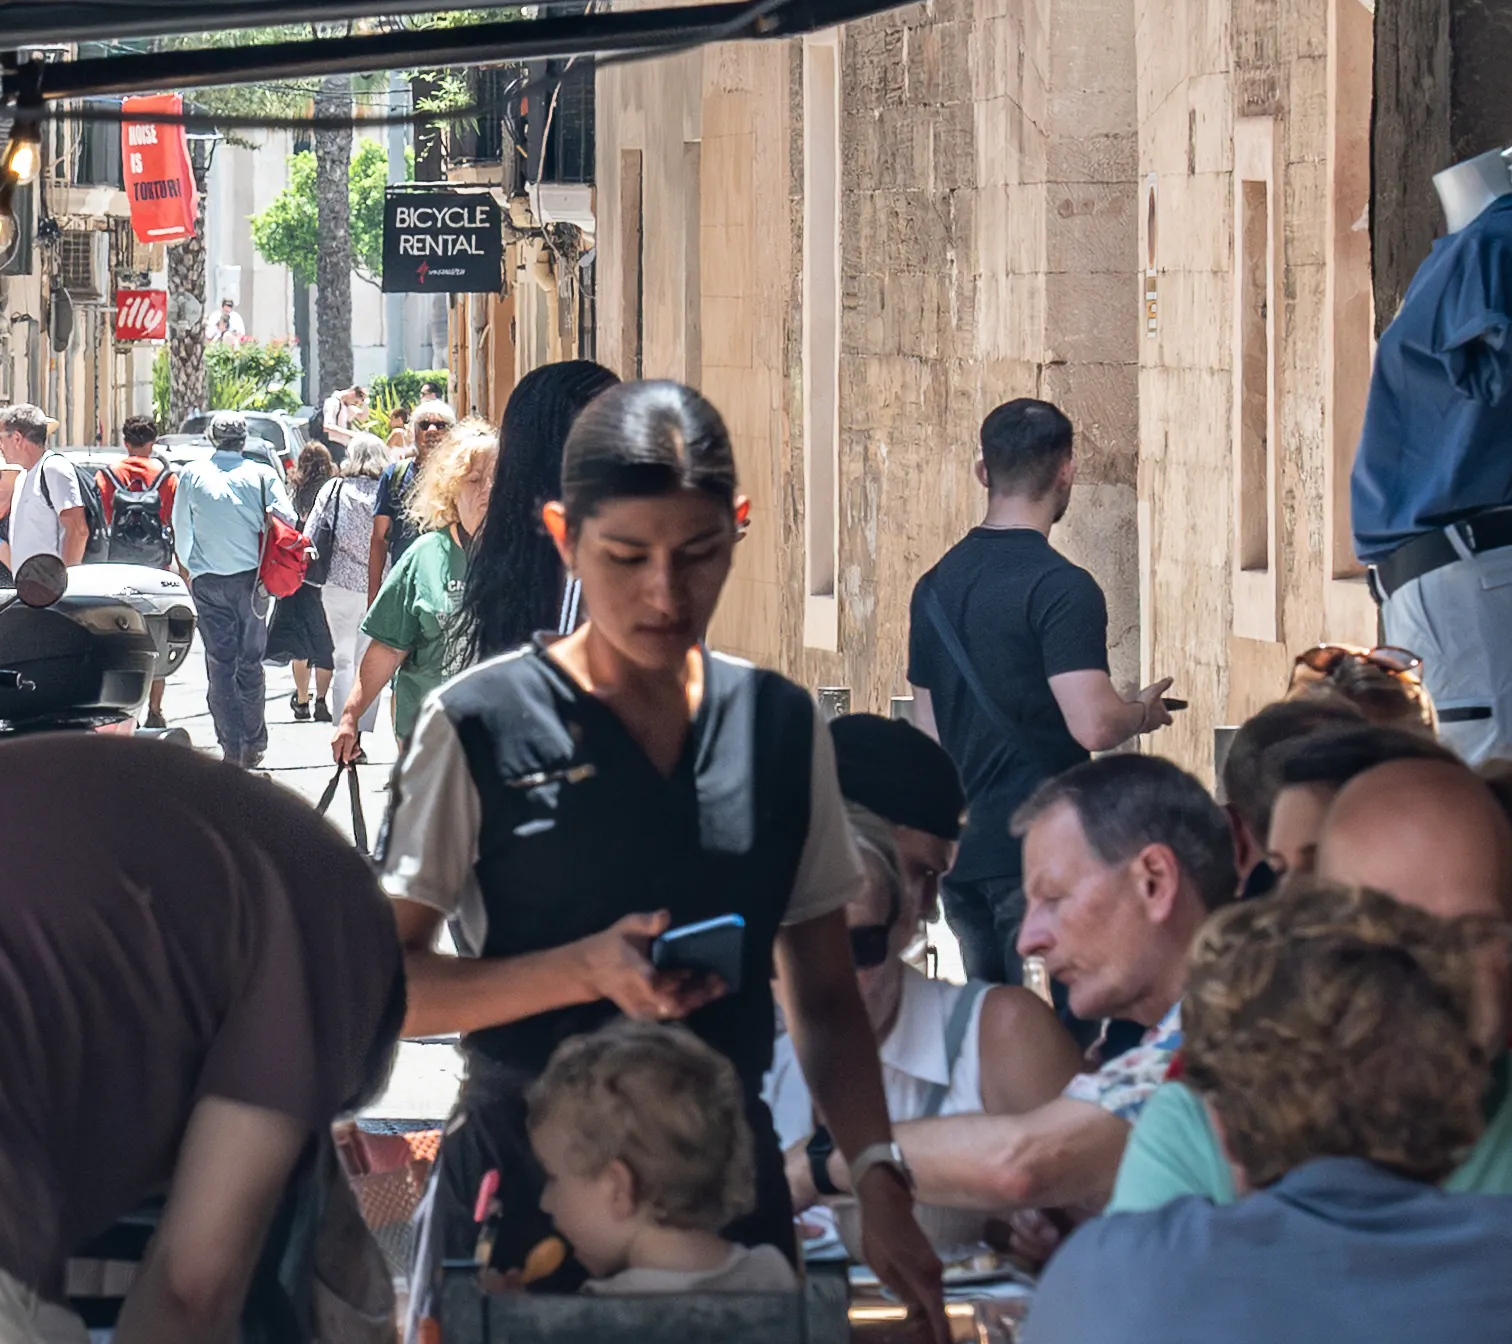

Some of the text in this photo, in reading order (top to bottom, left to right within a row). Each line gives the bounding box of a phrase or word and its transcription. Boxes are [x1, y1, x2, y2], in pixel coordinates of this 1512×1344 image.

[128, 124, 158, 146] NOISE
[130, 153, 143, 174] IS
[396, 206, 490, 228] BICYCLE
[399, 235, 485, 256] RENTAL
[118, 298, 163, 336] illy
